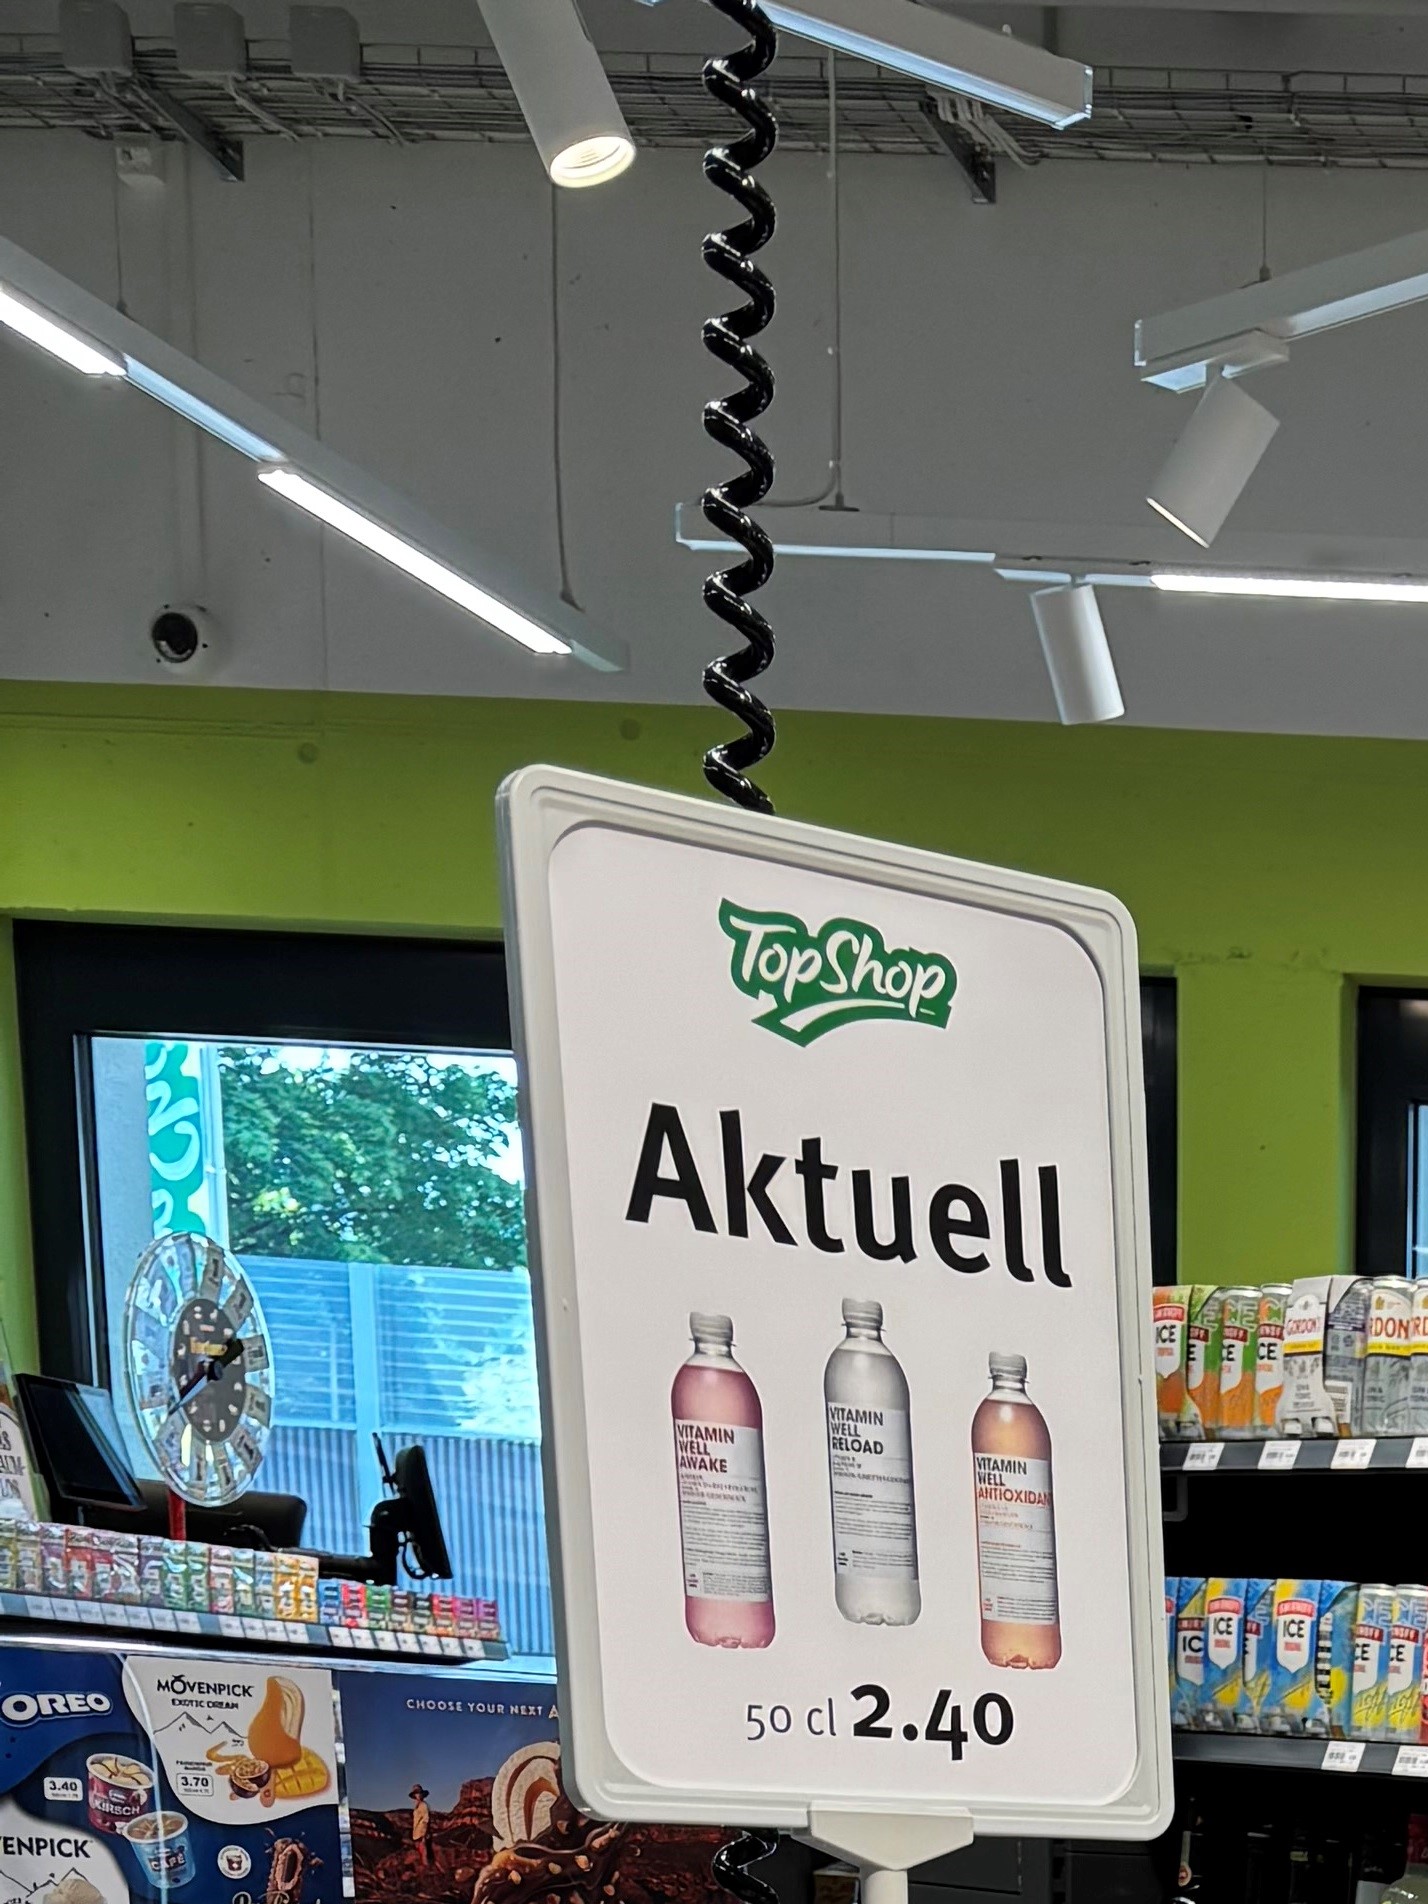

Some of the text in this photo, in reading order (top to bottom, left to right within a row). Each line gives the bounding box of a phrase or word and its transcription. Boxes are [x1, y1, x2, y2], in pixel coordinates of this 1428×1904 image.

[625, 1102, 1072, 1288] Aktuell
[830, 1406, 884, 1427] VITAMIN
[677, 1423, 735, 1446] VITAMIN
[831, 1422, 861, 1438] WELL
[678, 1439, 711, 1457] WELL
[831, 1436, 884, 1455] RELOAD
[678, 1455, 728, 1474] AWAKE
[976, 1456, 1028, 1475] VITAMIN
[977, 1471, 1006, 1487] WELL
[2, 1692, 111, 1721] OREO
[406, 1699, 463, 1712] CHOOSE
[469, 1701, 505, 1715] YOUR
[510, 1703, 543, 1717] NEXT
[746, 1684, 1015, 1763] 50 cl 2.40
